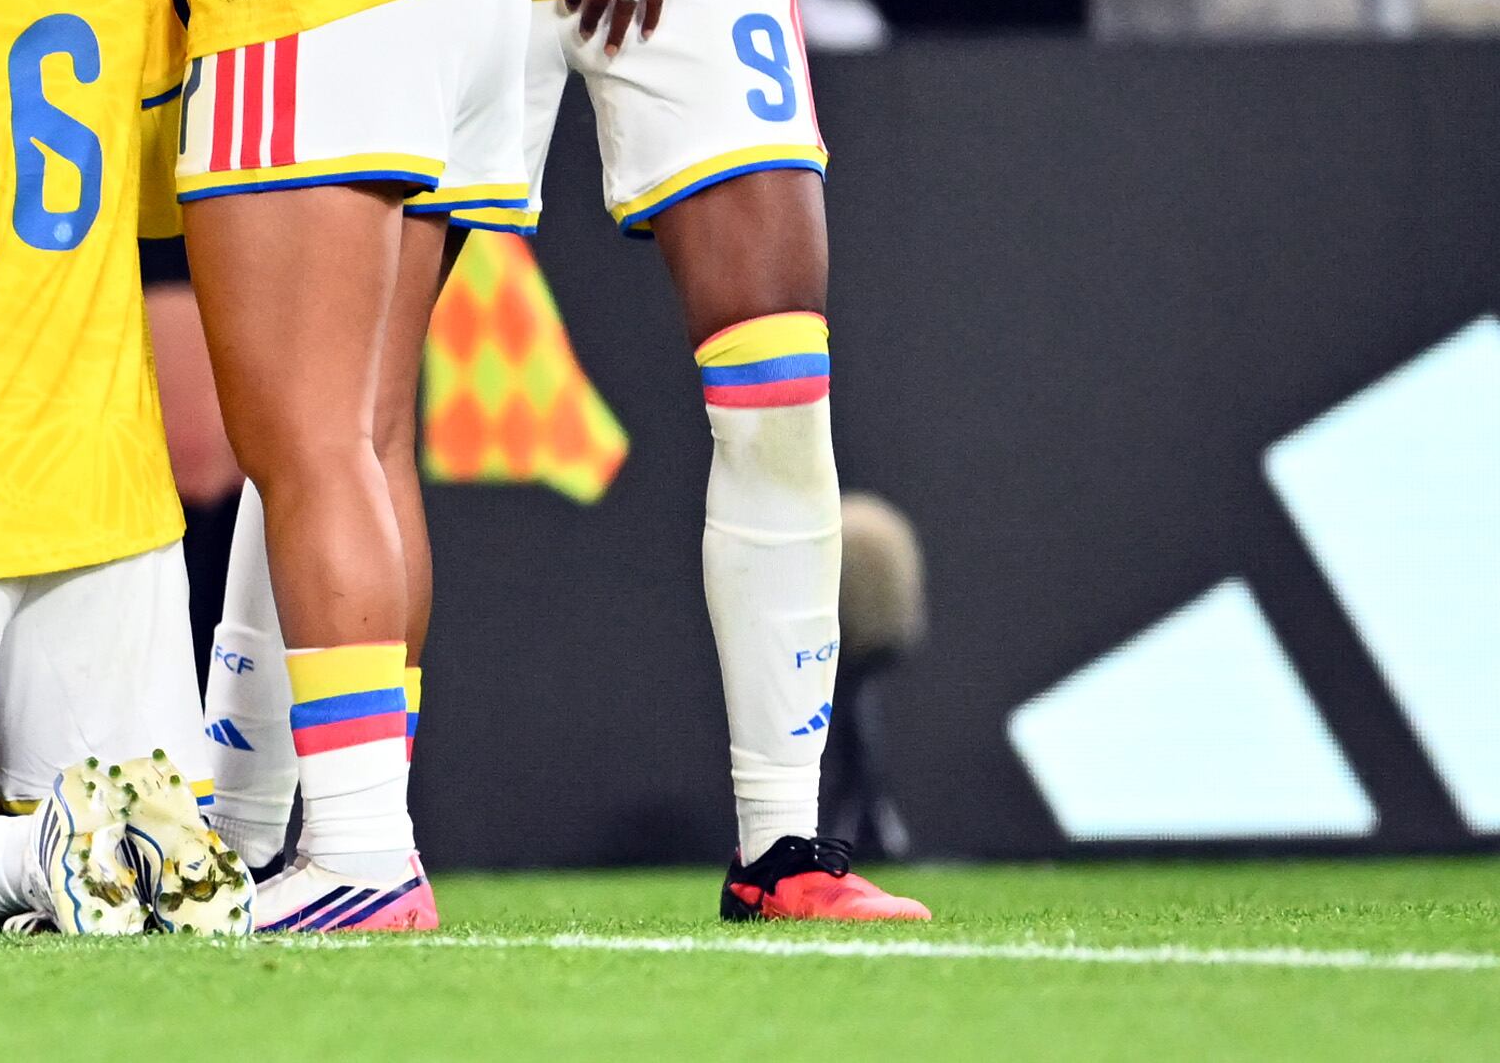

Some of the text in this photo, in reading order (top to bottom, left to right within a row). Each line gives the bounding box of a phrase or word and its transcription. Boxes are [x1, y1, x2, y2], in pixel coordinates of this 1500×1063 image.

[731, 12, 797, 123] 9
[215, 644, 255, 675] FCF
[796, 639, 839, 669] FCF
